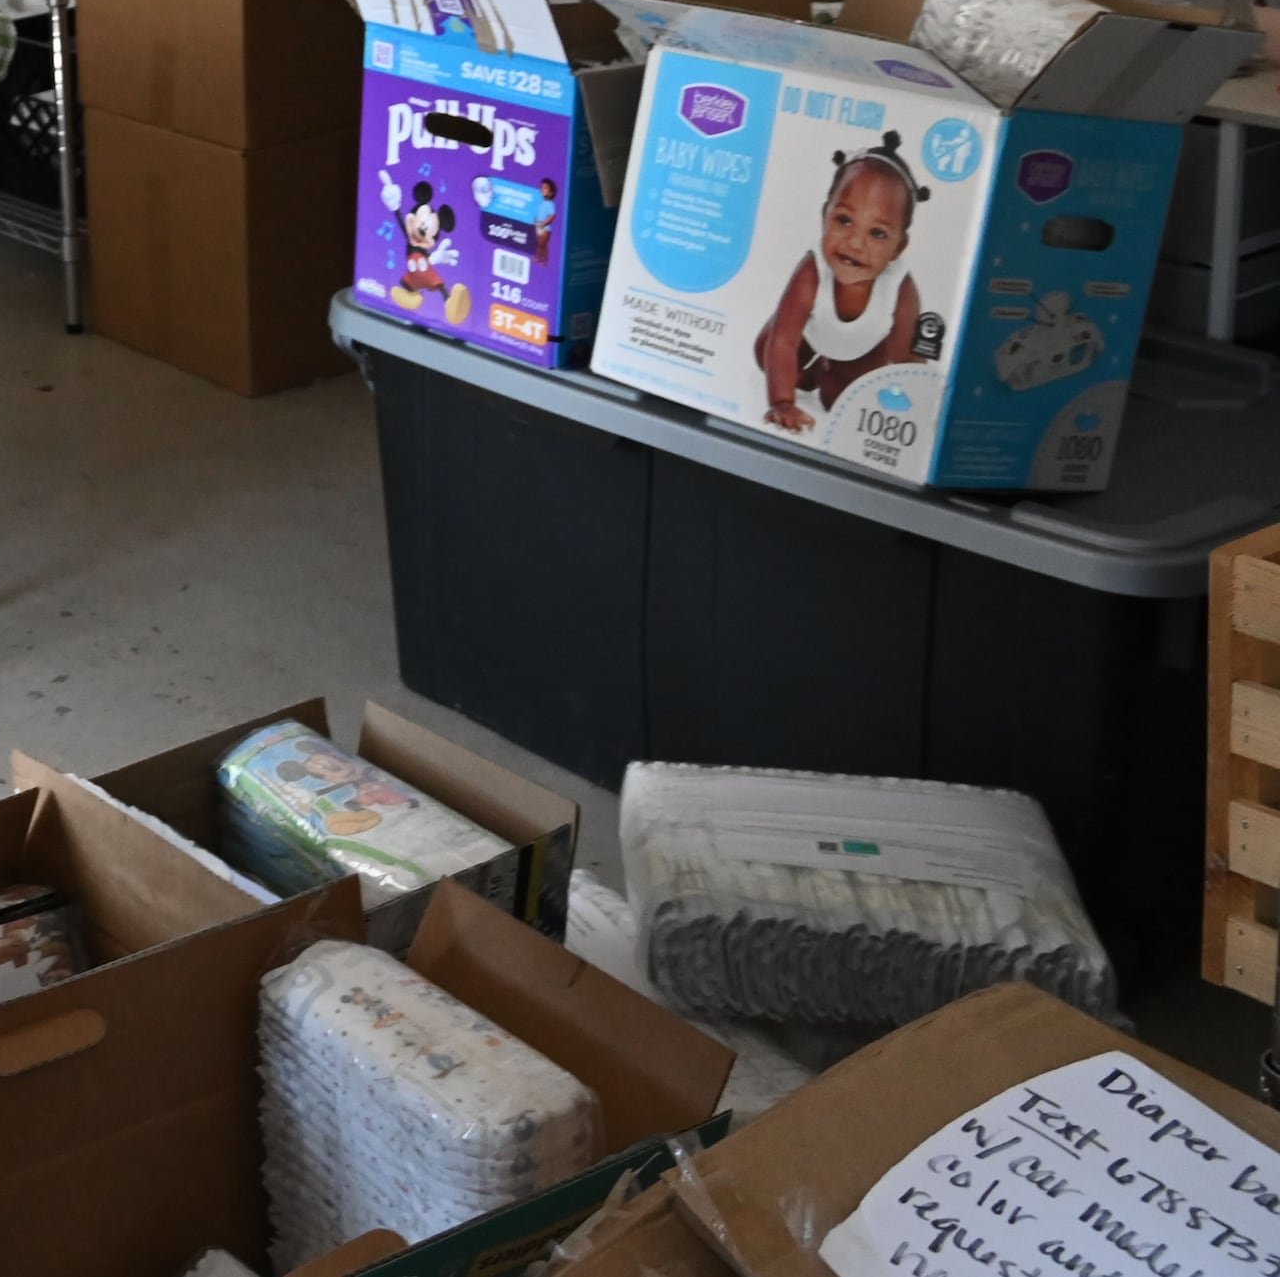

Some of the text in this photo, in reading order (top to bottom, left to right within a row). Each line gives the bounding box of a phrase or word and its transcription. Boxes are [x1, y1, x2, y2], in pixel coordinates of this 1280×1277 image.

[460, 61, 507, 87] SAVE
[508, 69, 543, 96] $28
[804, 90, 837, 121] NOT
[655, 136, 753, 184] BABY WIPES
[621, 293, 728, 337] MADE WITHOUT
[855, 407, 917, 447] 1080
[1017, 1087, 1111, 1154] Text
[1097, 1068, 1230, 1162] Diaper
[961, 1117, 1023, 1160] w/
[1008, 1154, 1087, 1199] car
[927, 1153, 1038, 1226] color
